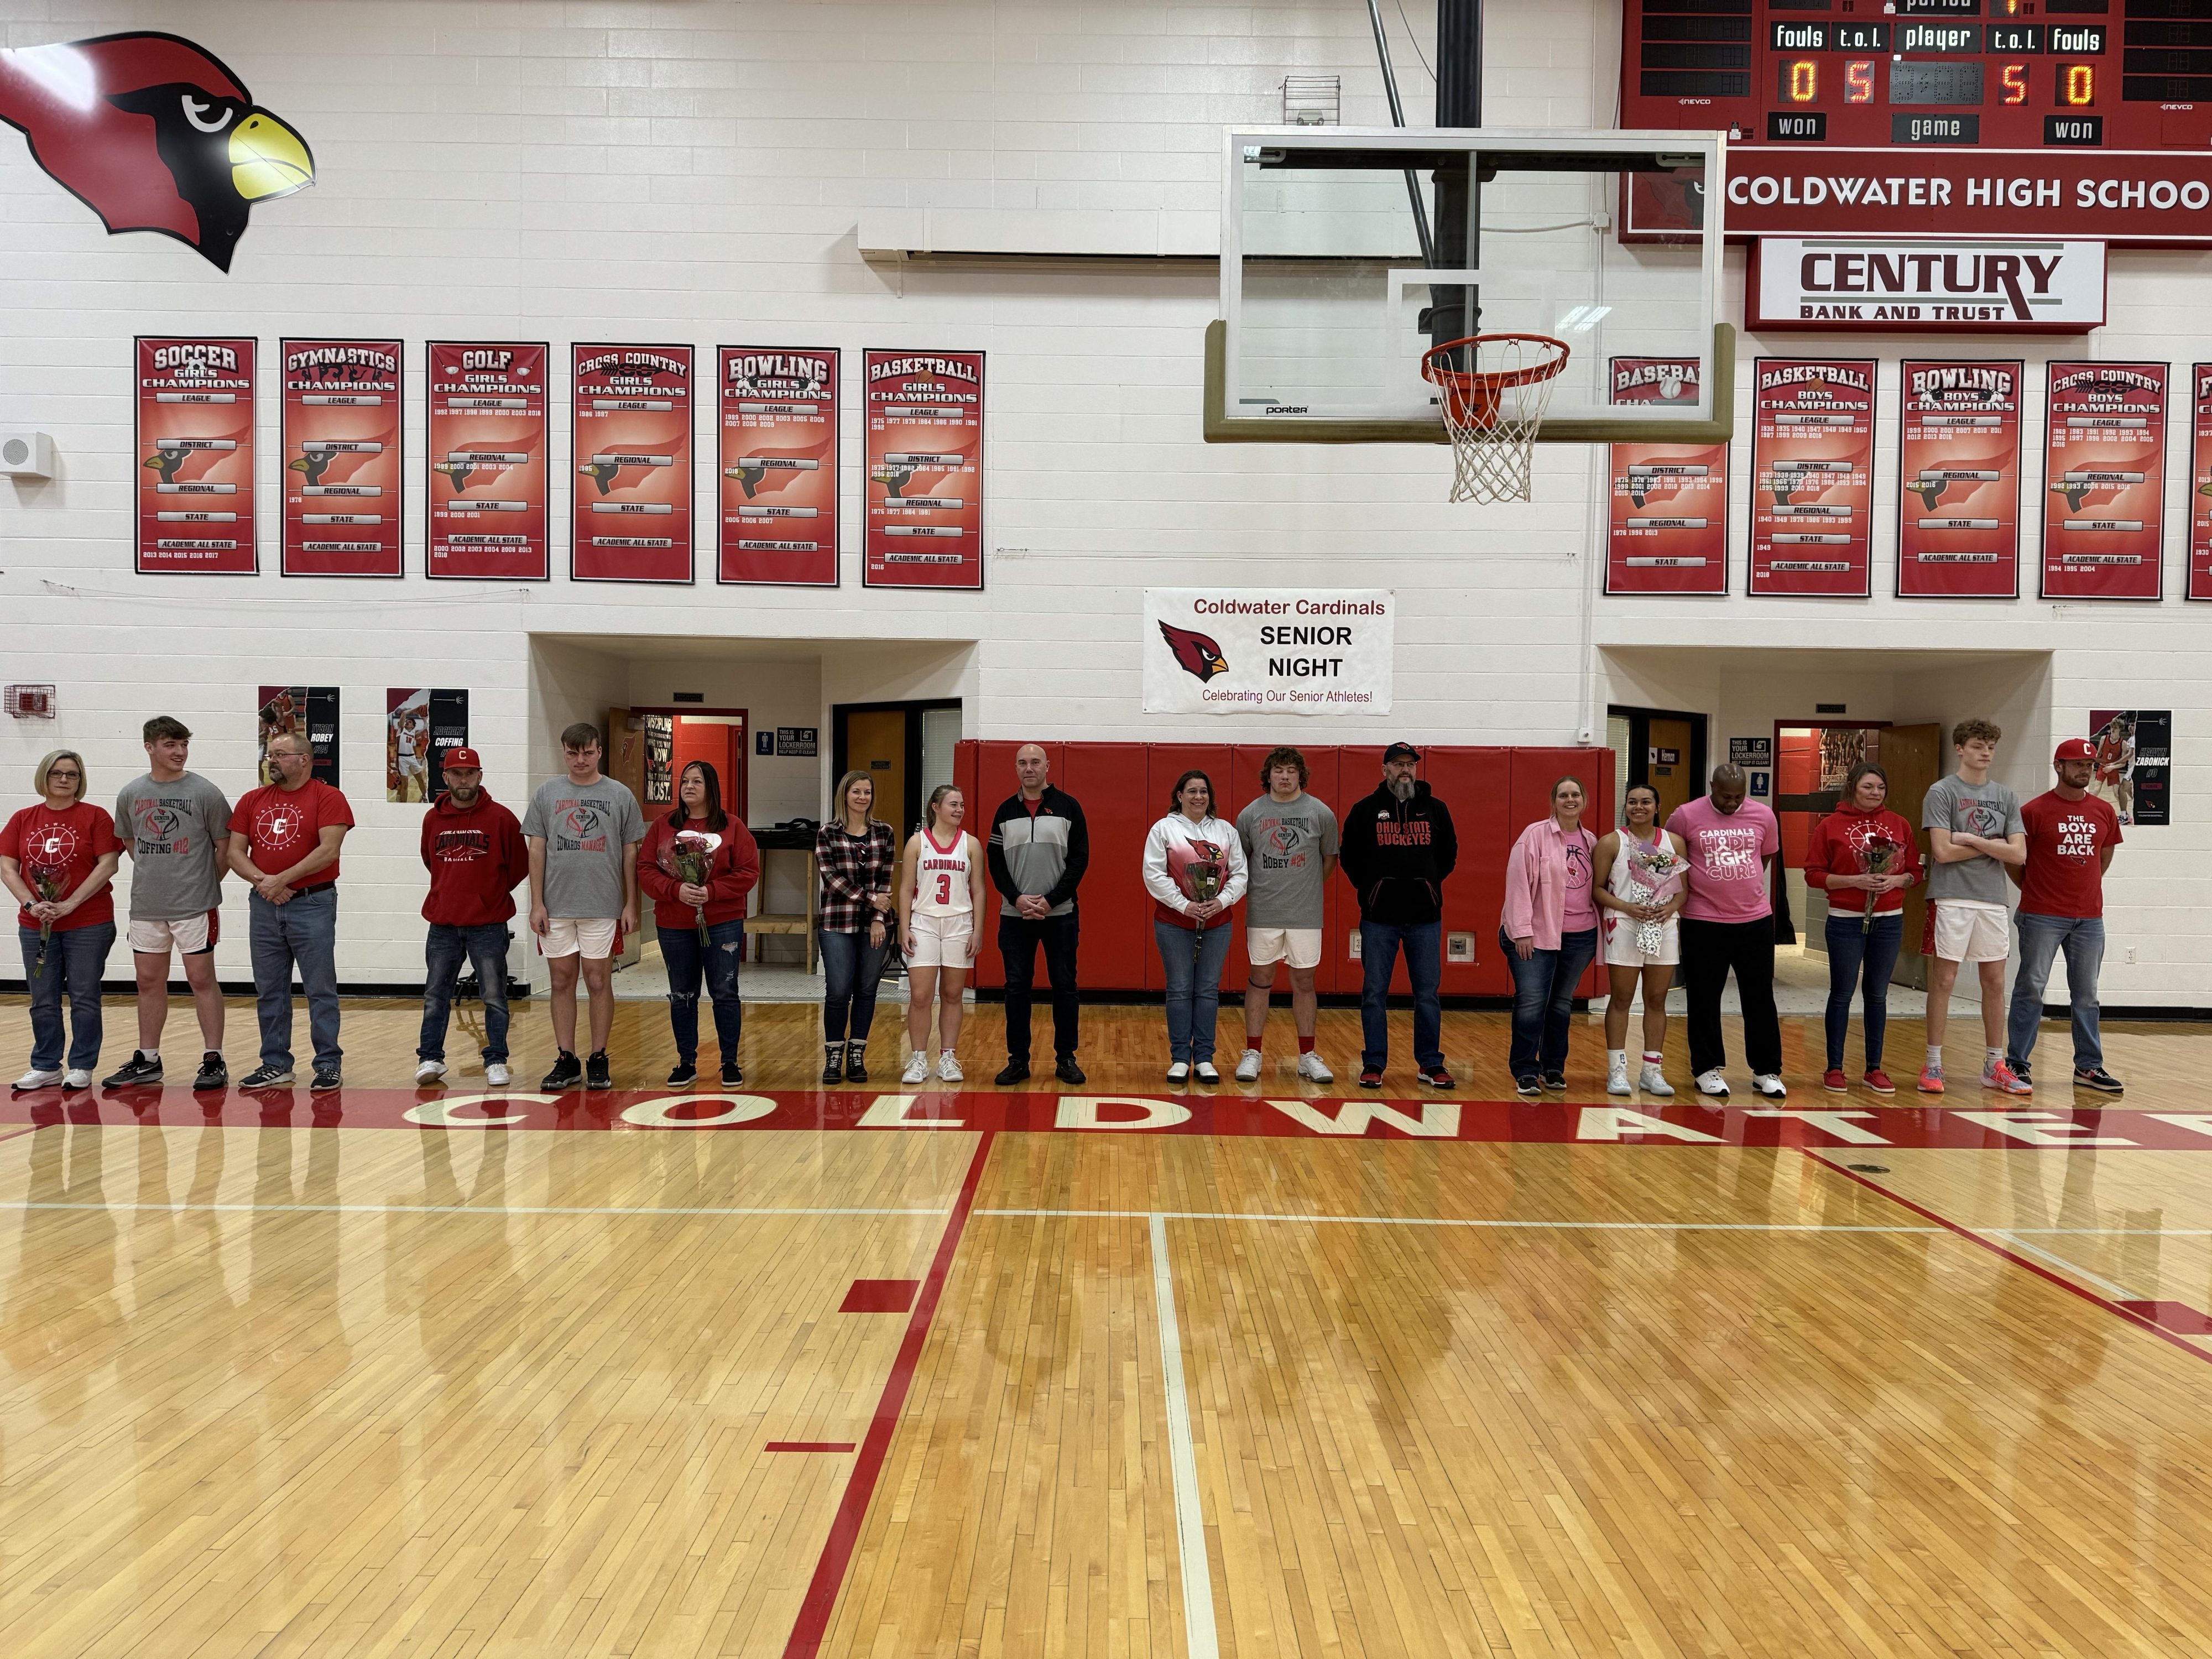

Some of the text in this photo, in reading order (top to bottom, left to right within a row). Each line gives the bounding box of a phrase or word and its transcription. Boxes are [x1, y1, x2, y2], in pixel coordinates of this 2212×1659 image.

[1777, 25, 1823, 48] fouls
[1840, 28, 1880, 46] t.o.l.
[1906, 25, 1970, 50] player
[1995, 31, 2036, 49] t.o.l.
[2054, 29, 2099, 51] fouls
[1792, 62, 1815, 101] 0
[1848, 62, 1871, 103] 5
[2003, 65, 2026, 104] 5
[2068, 66, 2092, 105] 0
[1780, 117, 1815, 135] won
[1912, 120, 1960, 140] game
[2055, 120, 2092, 139] won
[1728, 176, 1950, 206] COLDWATER
[1967, 178, 2061, 208] HIGH
[1800, 253, 2063, 320] CENTURY
[1800, 306, 2005, 320] BANK AND TRUST
[154, 346, 237, 372] SOCCER
[288, 348, 395, 371] GYMNASTICS
[462, 351, 513, 371] GOLF
[625, 353, 687, 378] COUNTRY
[174, 369, 217, 378] GIRLS
[729, 355, 828, 382] BOWLING
[870, 358, 977, 383] BASKETBALL
[142, 379, 250, 388] CHAMPIONS
[609, 377, 652, 386] GIRLS
[757, 379, 800, 389] GIRLS
[1761, 366, 1869, 388] BASKETBALL
[1912, 368, 2011, 394] BOWLING
[2101, 371, 2162, 395] COUNTRY
[288, 382, 395, 390] CHAMPIONS
[434, 384, 541, 393] CHAMPIONS
[578, 387, 686, 397] CHAMPIONS
[902, 383, 945, 392] GIRLS
[724, 388, 832, 400] CHAMPIONS
[870, 392, 977, 403] CHAMPIONS
[1797, 391, 1833, 400] BOYS
[1944, 392, 1979, 401] BOYS
[2088, 394, 2123, 403] BOYS
[1266, 405, 1308, 415] porter
[1761, 400, 1869, 410] CHAMPIONS
[1907, 402, 2015, 411] CHAMPIONS
[2053, 403, 2160, 413] CHAMPIONS
[1193, 598, 1385, 615] Coldwater Cardinals
[1260, 626, 1353, 645] SENIOR
[1269, 658, 1343, 677] NIGHT
[1202, 689, 1373, 703] Celebrating Our Senior Athletes!
[312, 724, 334, 733] TYSON
[434, 726, 466, 735] ZACHARY
[311, 733, 333, 742] ROBEY
[435, 737, 463, 747] COFFING
[458, 750, 466, 759] C
[654, 748, 667, 763] NOW
[2083, 743, 2091, 755] C
[2139, 748, 2167, 757] KEAVYN
[2135, 757, 2169, 766] ZABONICK
[2146, 769, 2158, 778] #0
[647, 781, 670, 801] MOST.
[134, 799, 192, 817] CARDINAL BASKETBALL
[555, 799, 610, 817] CARDINAL BASKETBALL
[273, 818, 286, 833] C
[1259, 817, 1309, 834] CARDINAL BASKETBALL
[1376, 821, 1431, 834] OHIO STATE
[1699, 828, 1754, 837] CARDINALS
[2058, 822, 2096, 834] BOYS
[45, 838, 60, 853] C
[137, 836, 189, 854] COFFING #12
[557, 834, 606, 852] EDWARDS MANAGER
[1377, 833, 1431, 846] BUCKEYES
[2063, 833, 2092, 844] ARE
[2057, 844, 2095, 856] BACK
[923, 859, 965, 872] CARDINALS
[1262, 851, 1306, 869] ROBEY #24
[1704, 850, 1754, 867] FIGHT
[1706, 863, 1757, 881] CURE
[936, 874, 950, 905] 3
